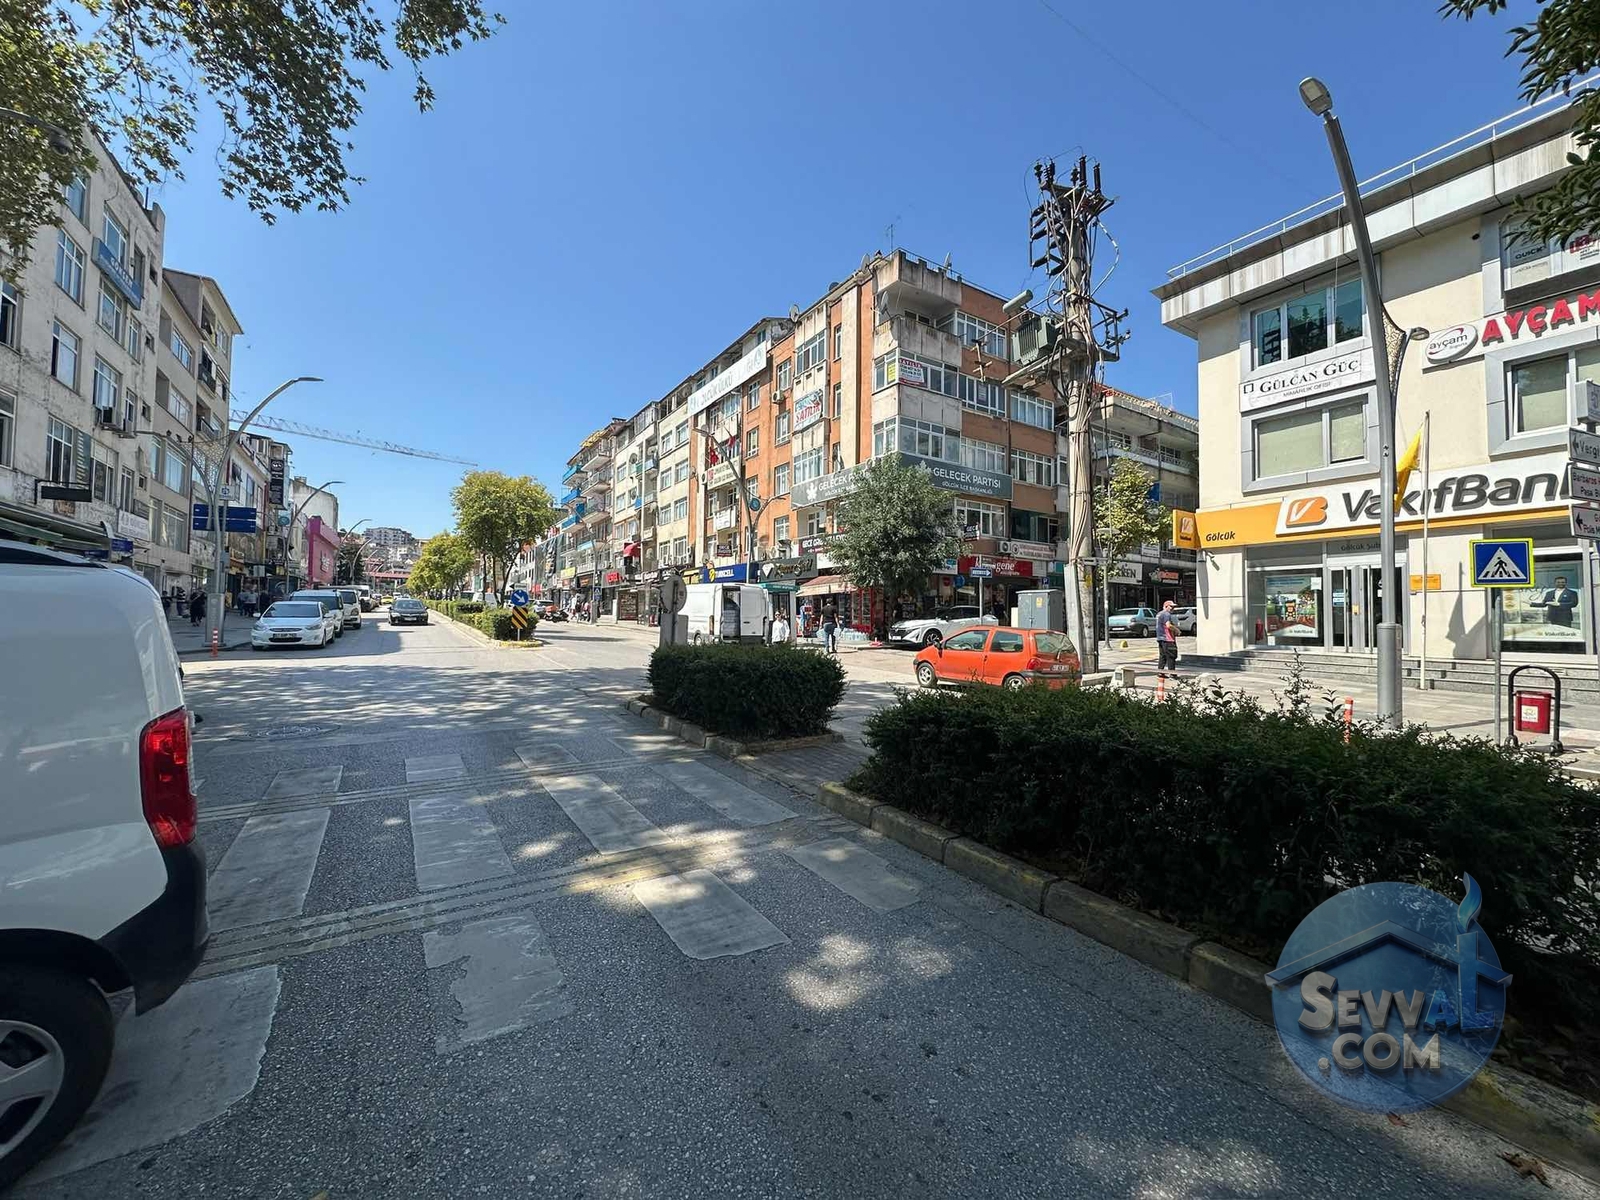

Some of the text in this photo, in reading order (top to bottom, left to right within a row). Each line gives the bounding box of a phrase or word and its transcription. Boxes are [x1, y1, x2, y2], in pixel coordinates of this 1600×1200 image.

[1481, 288, 1600, 346] AYÇAM
[1429, 334, 1468, 351] ayçam
[1323, 360, 1358, 376] GÜÇ
[819, 474, 847, 491] GELECEK
[933, 467, 971, 483] GELECEK
[1206, 530, 1236, 542] Gölcük
